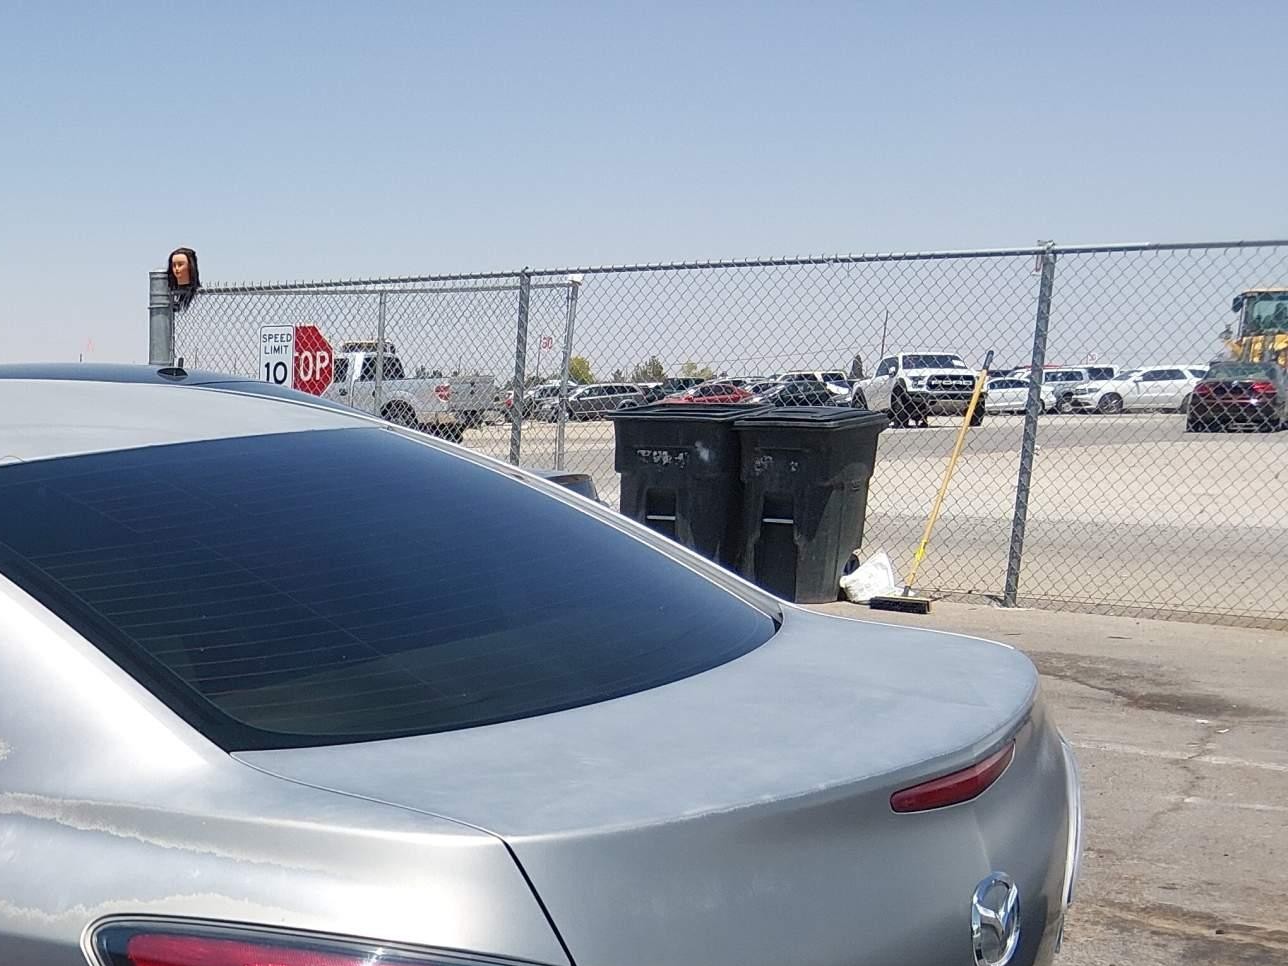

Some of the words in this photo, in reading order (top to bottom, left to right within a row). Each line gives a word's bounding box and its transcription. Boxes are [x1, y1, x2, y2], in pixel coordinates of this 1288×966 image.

[262, 333, 292, 343] SPEED
[264, 345, 288, 355] LIMIT
[264, 361, 288, 385] 10
